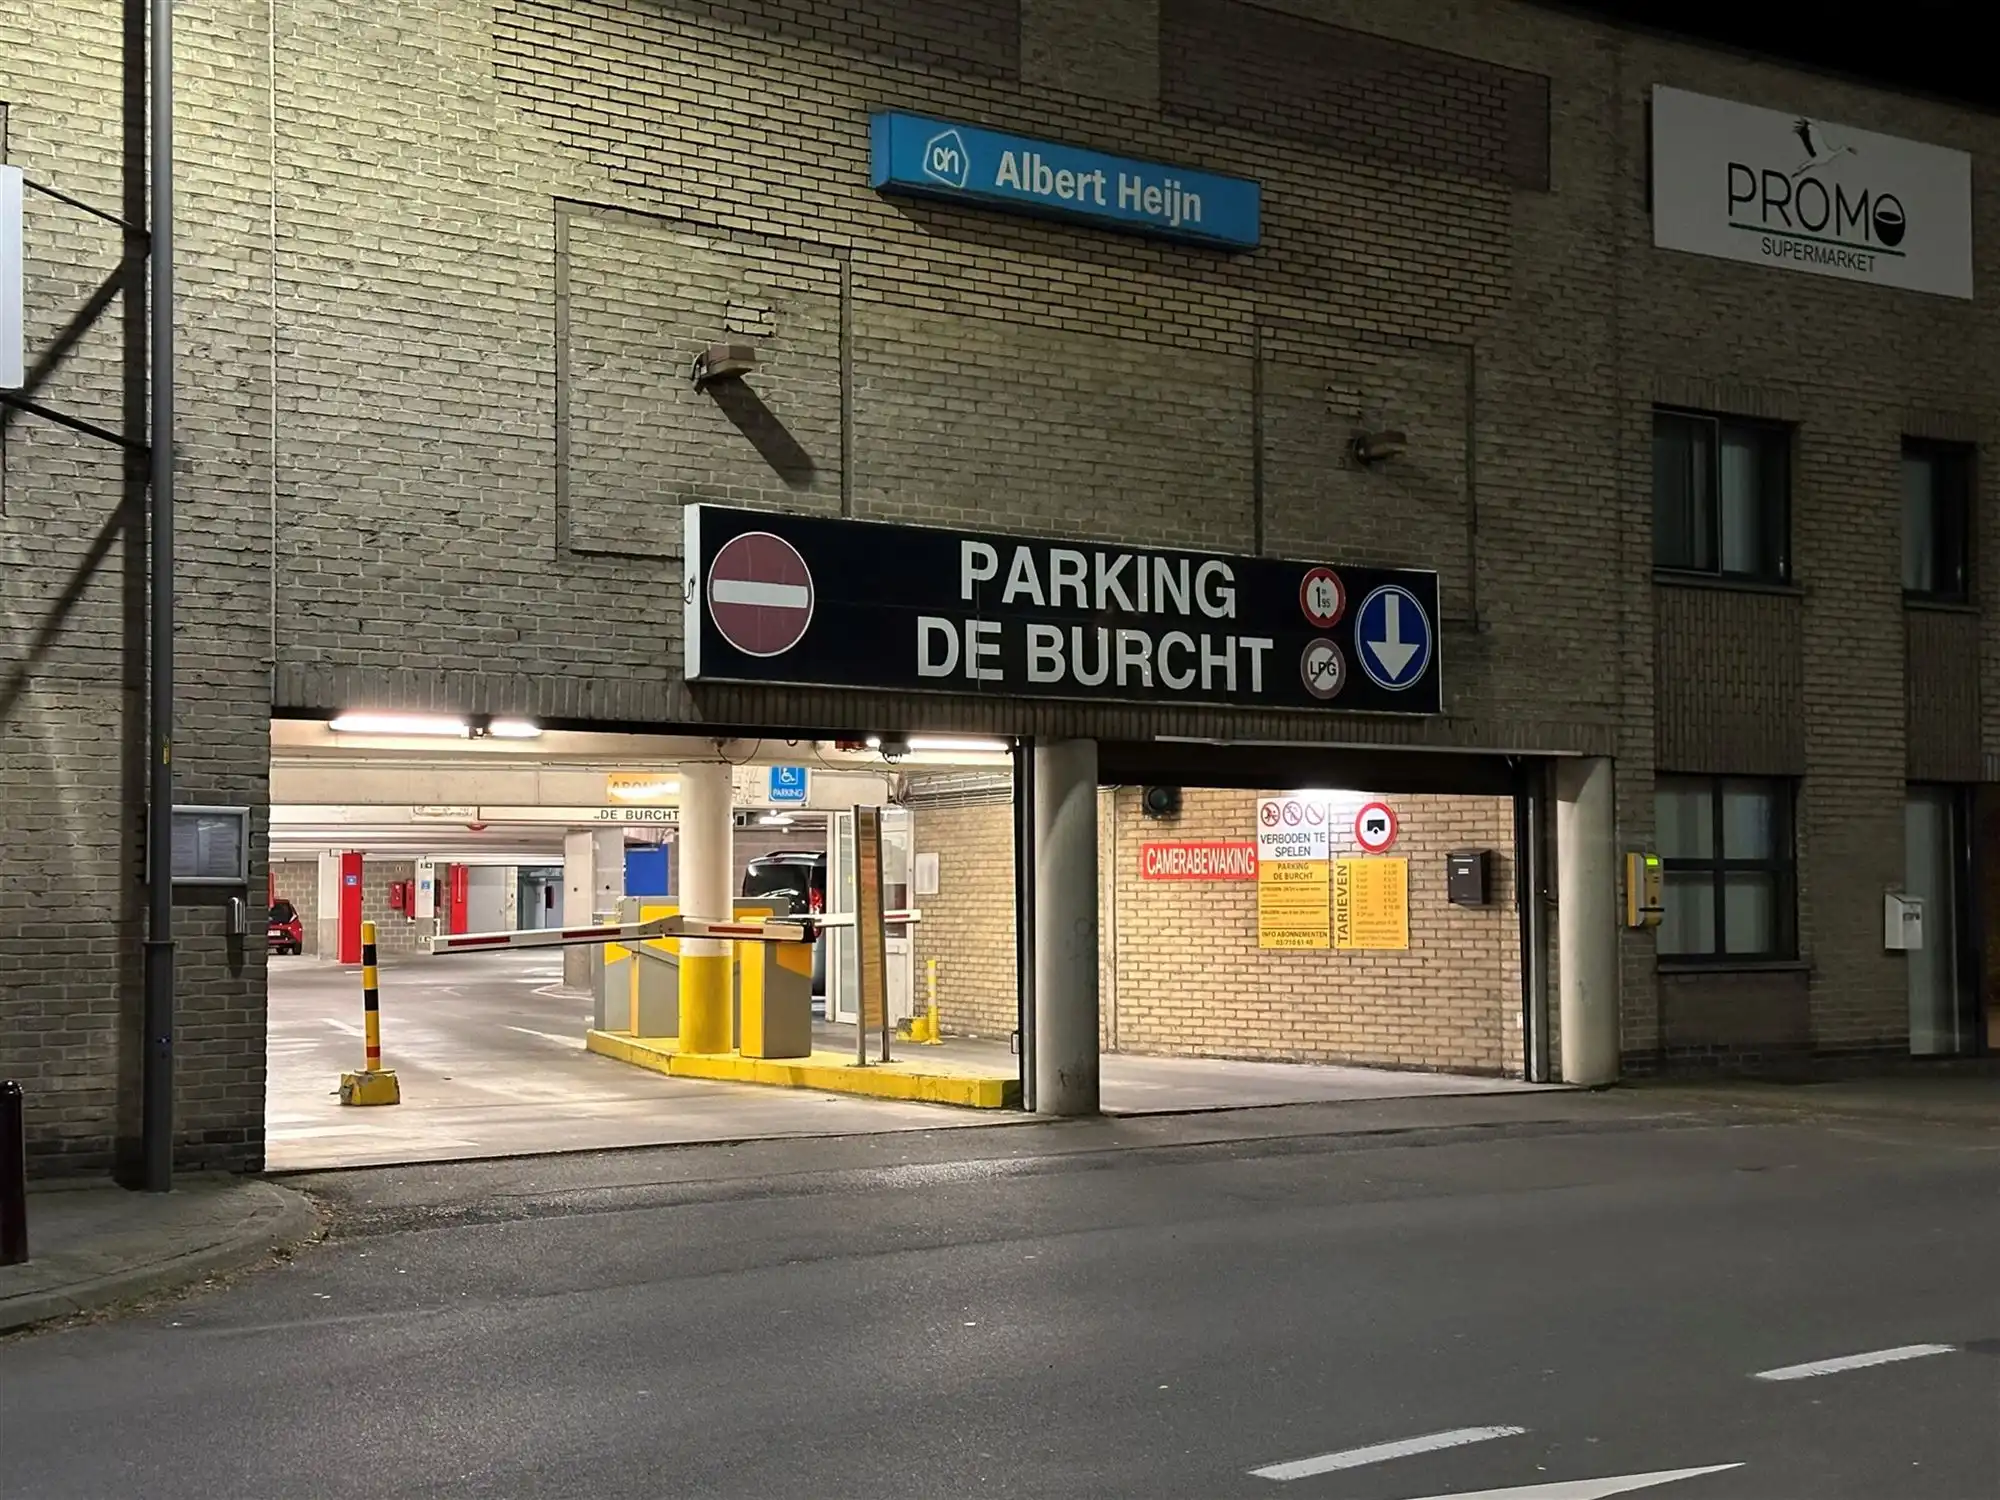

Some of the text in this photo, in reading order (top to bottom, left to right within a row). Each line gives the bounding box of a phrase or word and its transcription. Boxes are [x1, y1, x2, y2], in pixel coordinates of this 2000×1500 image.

[995, 150, 1202, 227] Albert Heijn
[1727, 161, 1906, 247] PROMO
[1761, 236, 1876, 272] SUPERMARKET
[960, 540, 1236, 618] PARKING
[916, 616, 1274, 694] DE BURCHT
[1310, 660, 1337, 676] LPG
[772, 788, 804, 797] PARKING
[625, 810, 679, 820] BURCHT
[1260, 832, 1326, 845] VERBODEN TE
[1147, 847, 1255, 875] CAMERABEWAKING
[1275, 846, 1311, 857] SPELEN
[1273, 872, 1313, 880] DE BURCHT
[1277, 862, 1309, 870] PARKING
[1336, 865, 1349, 944] TARIEVEN
